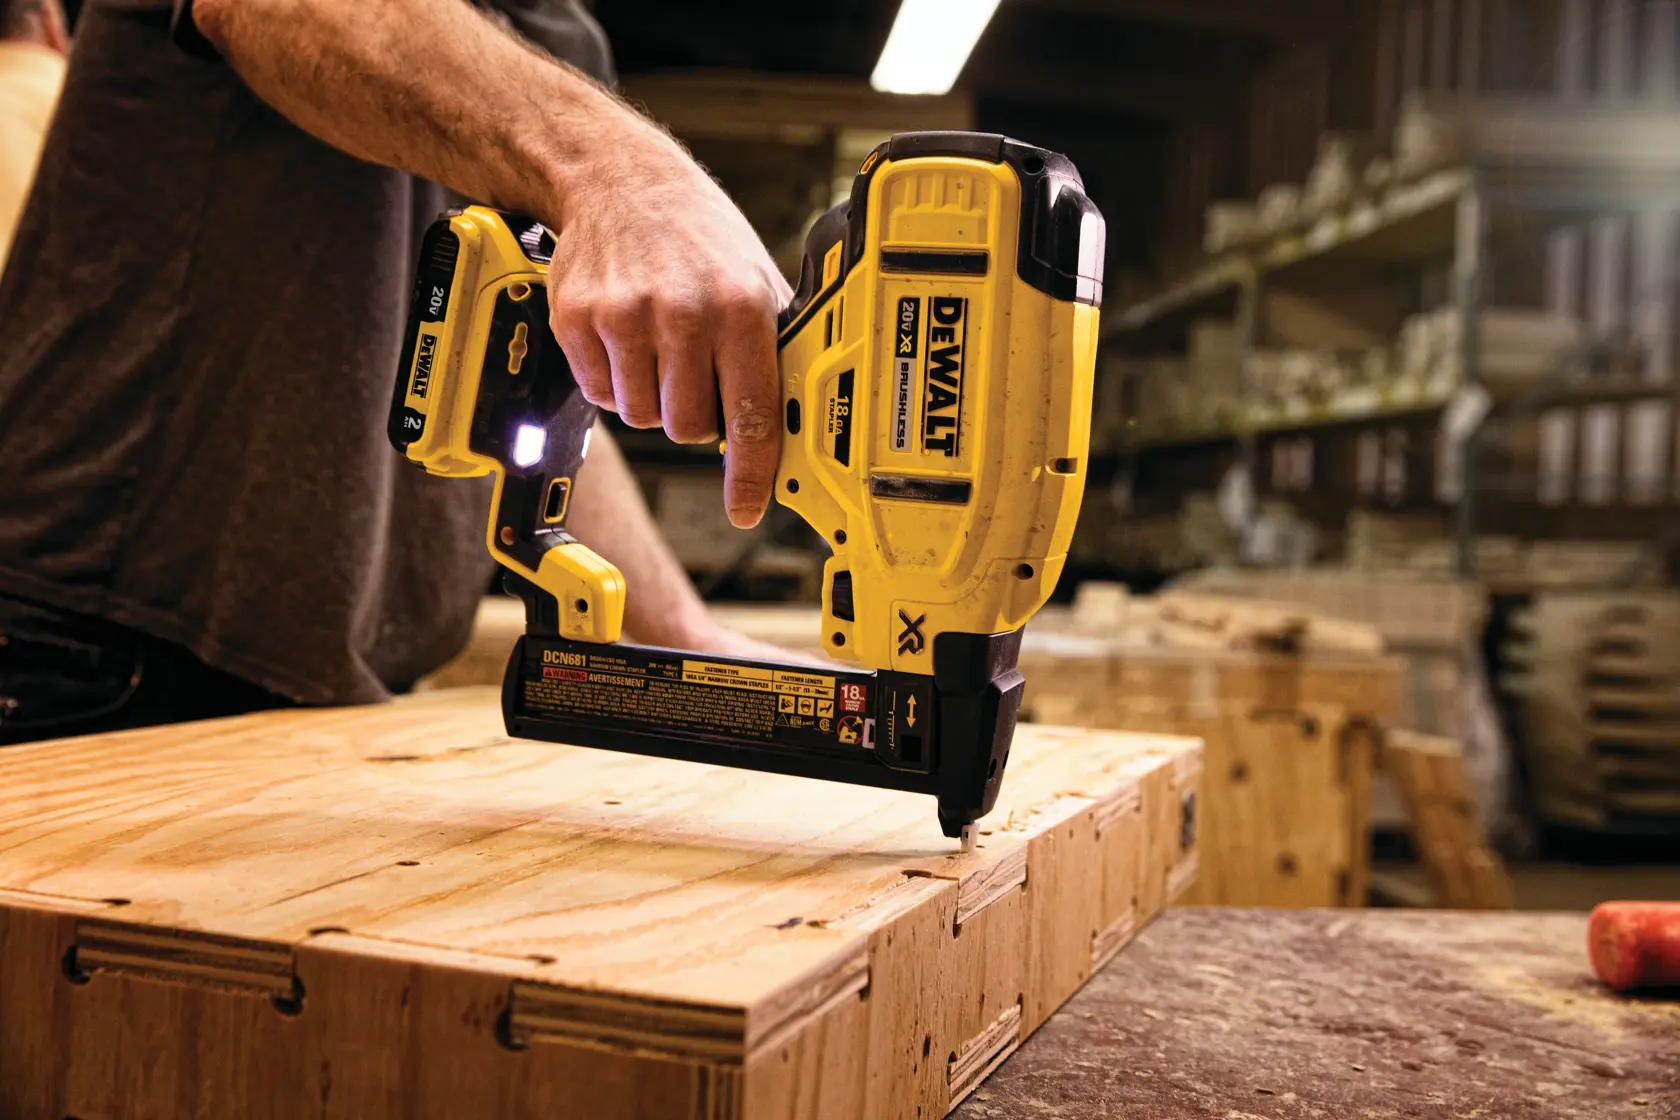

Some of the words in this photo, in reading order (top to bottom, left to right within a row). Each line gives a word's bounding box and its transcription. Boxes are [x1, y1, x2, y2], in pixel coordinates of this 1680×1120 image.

[899, 334, 912, 354] XR
[411, 333, 437, 399] DEWALT
[925, 296, 963, 457] DEWALT
[827, 397, 835, 434] STAPLER
[837, 396, 849, 416] 18
[896, 362, 910, 449] BRUSHLESS
[408, 416, 422, 430] 2
[898, 608, 926, 656] XR
[543, 650, 586, 667] DCN681
[552, 668, 586, 681] WARNING
[588, 673, 645, 688] AVERTISSEMENT
[707, 676, 729, 684] NARROW
[841, 685, 860, 700] 18
